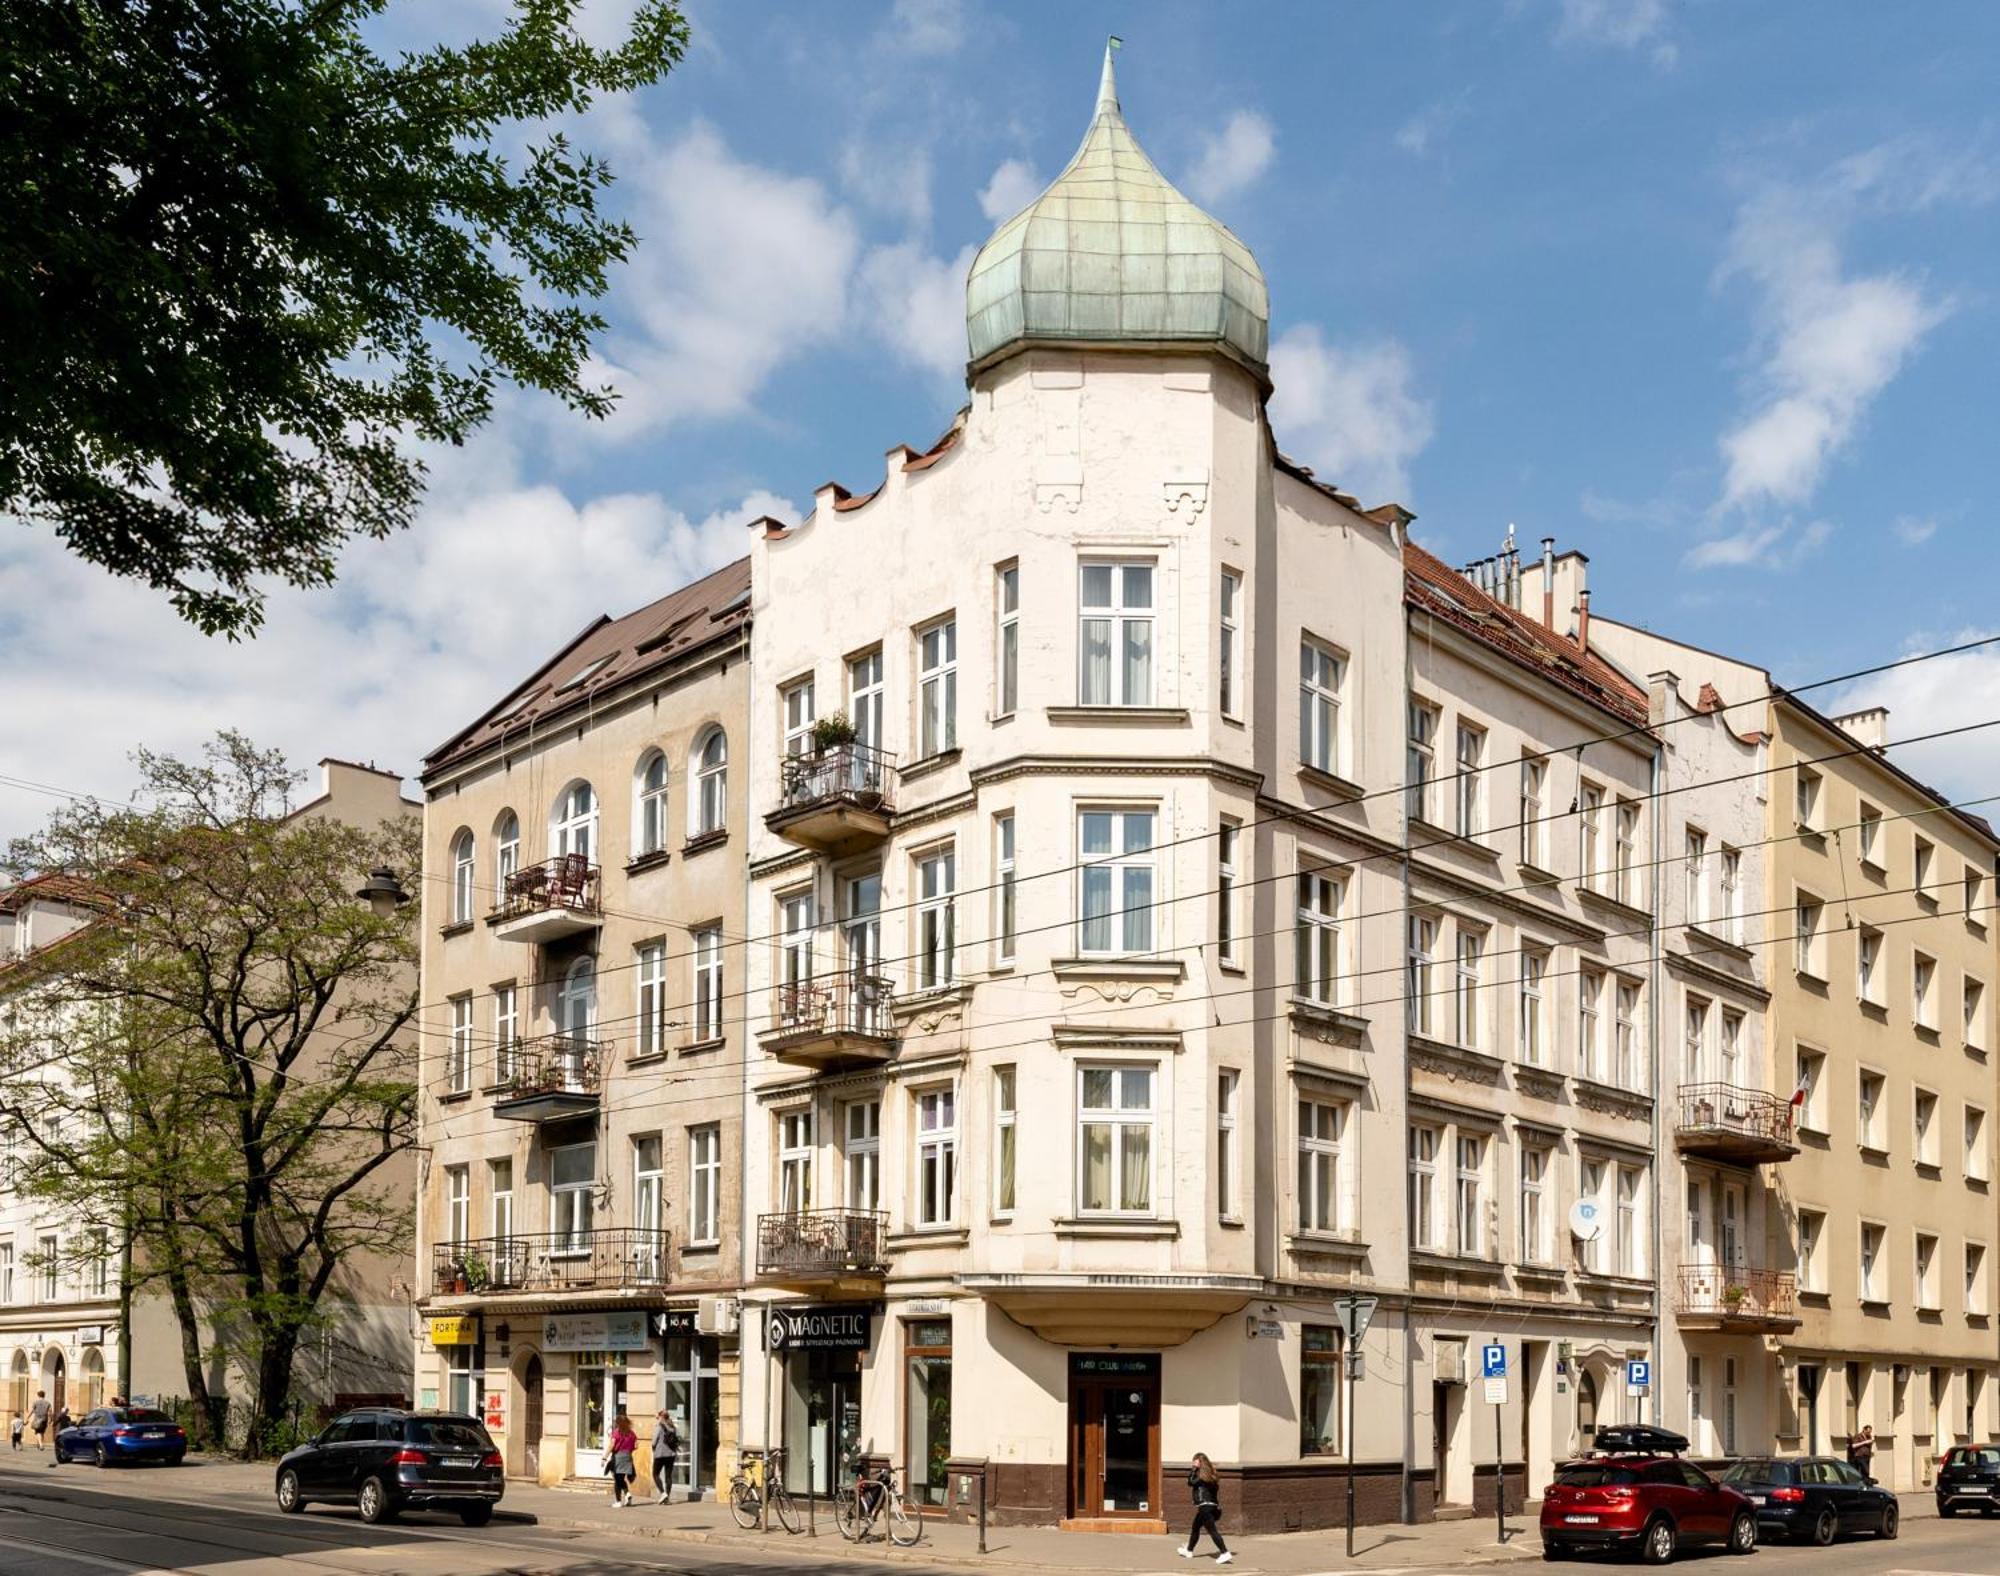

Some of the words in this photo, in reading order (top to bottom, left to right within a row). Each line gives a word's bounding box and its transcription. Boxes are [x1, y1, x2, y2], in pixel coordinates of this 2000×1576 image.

[788, 1314, 864, 1336] MAGNETIC
[1487, 1347, 1501, 1369] P
[1632, 1364, 1645, 1382] P
